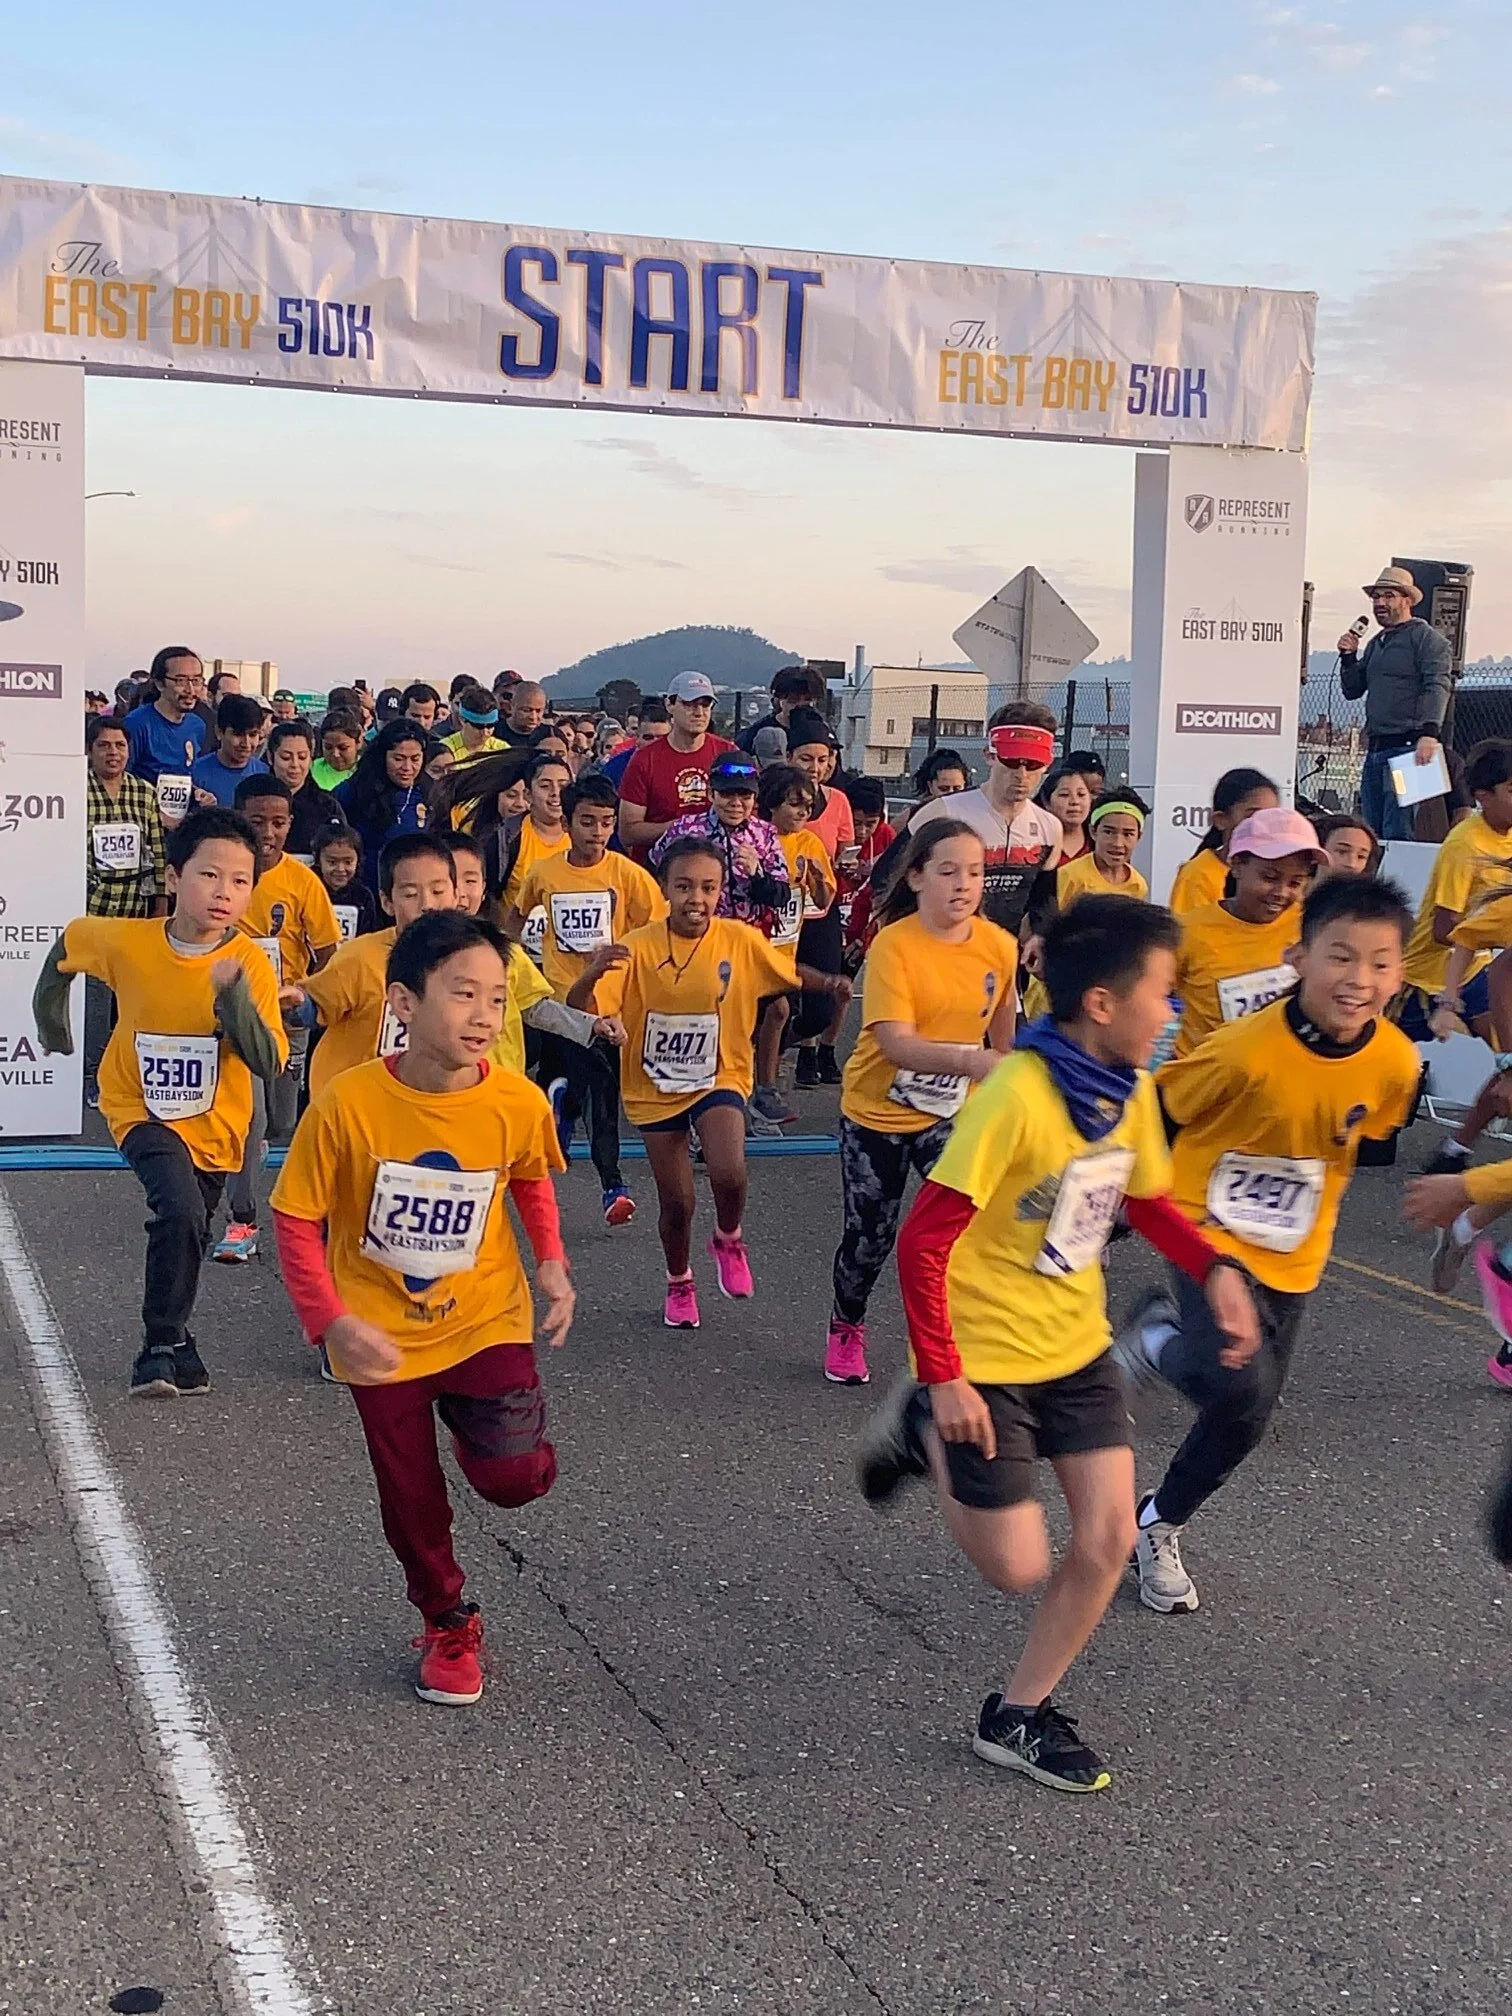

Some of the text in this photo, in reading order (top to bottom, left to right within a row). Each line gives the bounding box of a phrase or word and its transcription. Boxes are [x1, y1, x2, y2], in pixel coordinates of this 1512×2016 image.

[51, 240, 118, 277] The
[43, 275, 374, 361] EAST BAY 510K
[499, 244, 826, 401] START
[945, 319, 999, 350] The
[938, 349, 1207, 419] EAST BAY 510K
[1219, 499, 1291, 519] REPRESENT
[17, 560, 59, 585] 510K
[1182, 619, 1283, 642] EAST BAY 510K
[1182, 710, 1276, 729] DECATHLON
[0, 795, 64, 819] zon
[161, 787, 187, 802] 2505
[101, 835, 134, 851] 2542
[561, 908, 602, 929] 2567
[0, 926, 64, 943] REET
[655, 1031, 707, 1056] 2477
[143, 1056, 203, 1088] 2530
[386, 1194, 475, 1235] 2588
